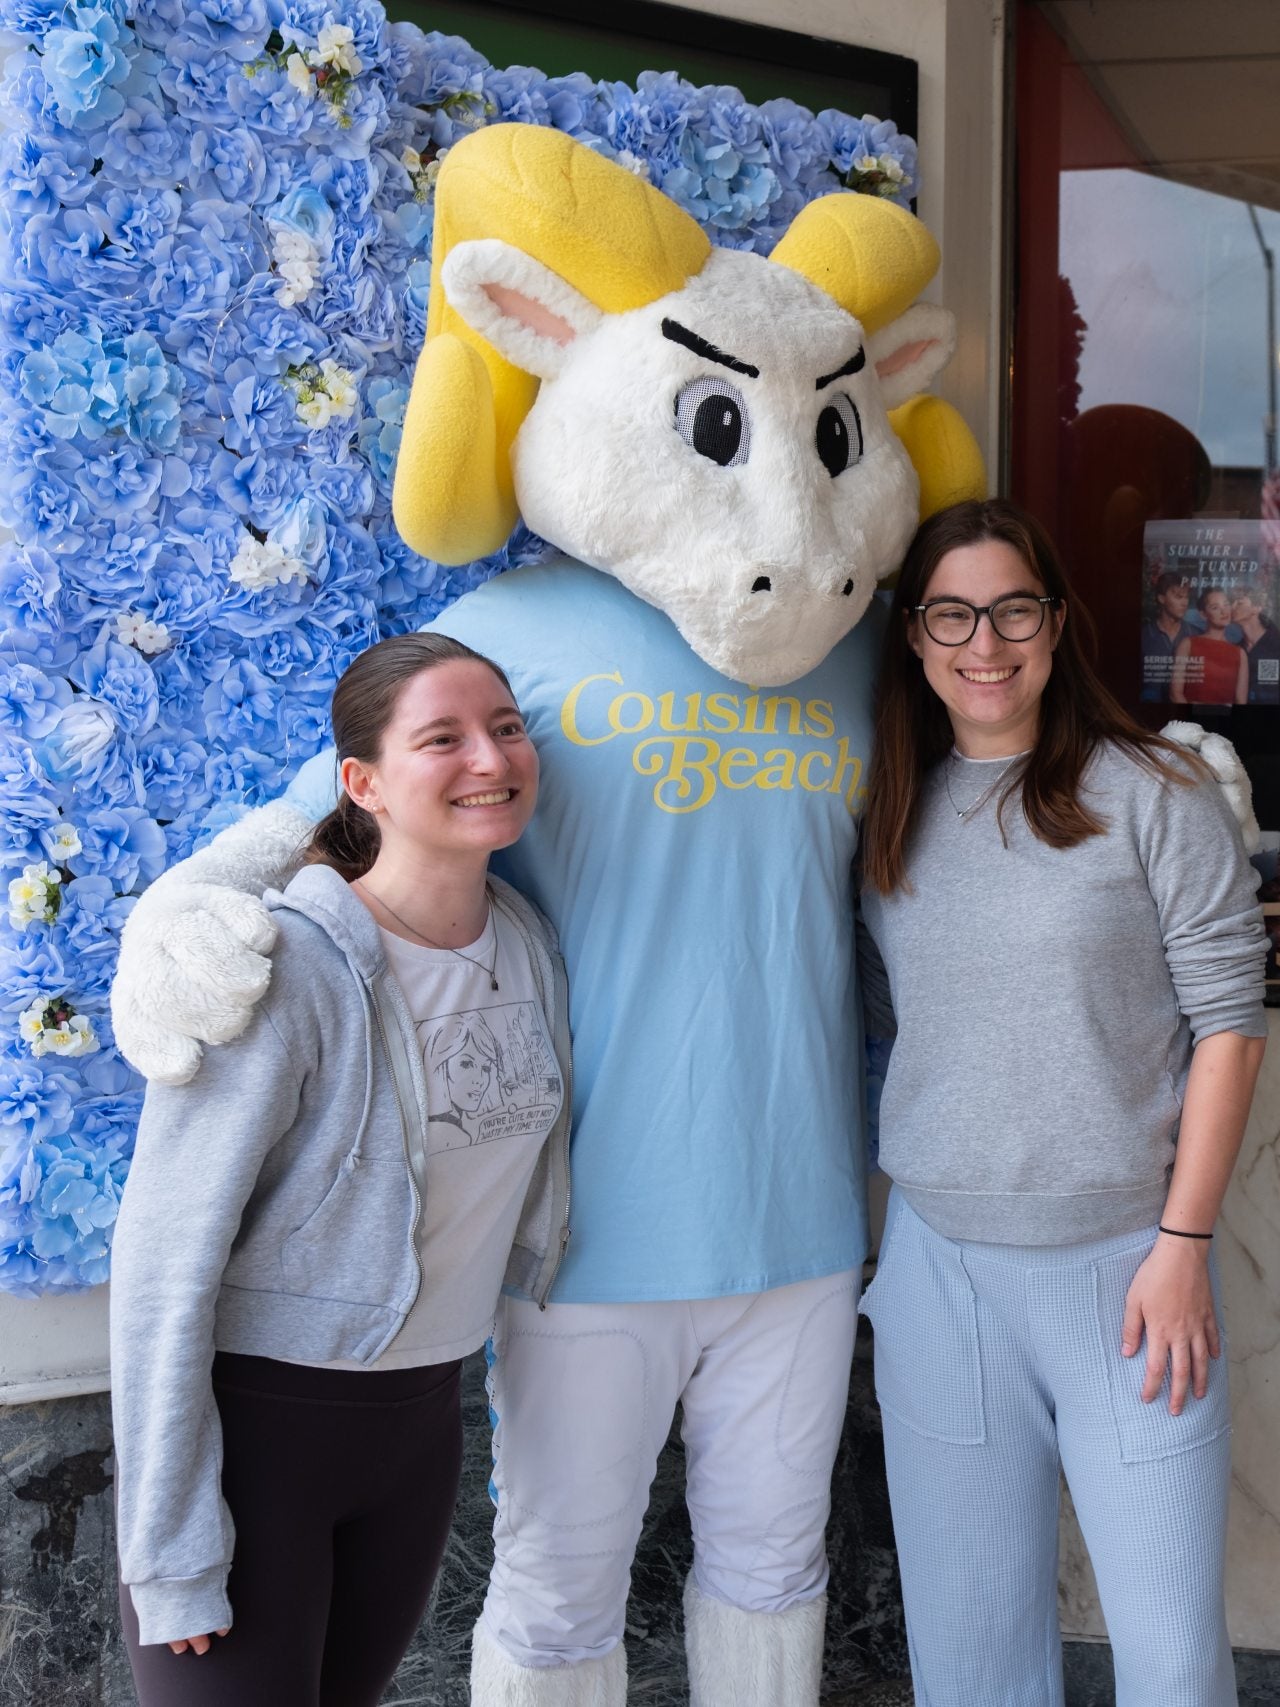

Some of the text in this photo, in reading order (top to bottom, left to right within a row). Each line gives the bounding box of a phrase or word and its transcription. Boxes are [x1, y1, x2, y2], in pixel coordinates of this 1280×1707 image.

[1195, 529, 1225, 541] THE
[1168, 545, 1245, 557] SUMMER I
[1199, 561, 1258, 573] TURNED
[1181, 577, 1239, 588] PRETTY
[1144, 656, 1174, 664] SERIES
[560, 671, 836, 747] Cousins
[632, 736, 870, 815] Beach
[483, 1108, 554, 1130] YOU'RE CUTE BUT NOT
[503, 1124, 516, 1135] MY
[535, 1118, 552, 1129] CUTE
